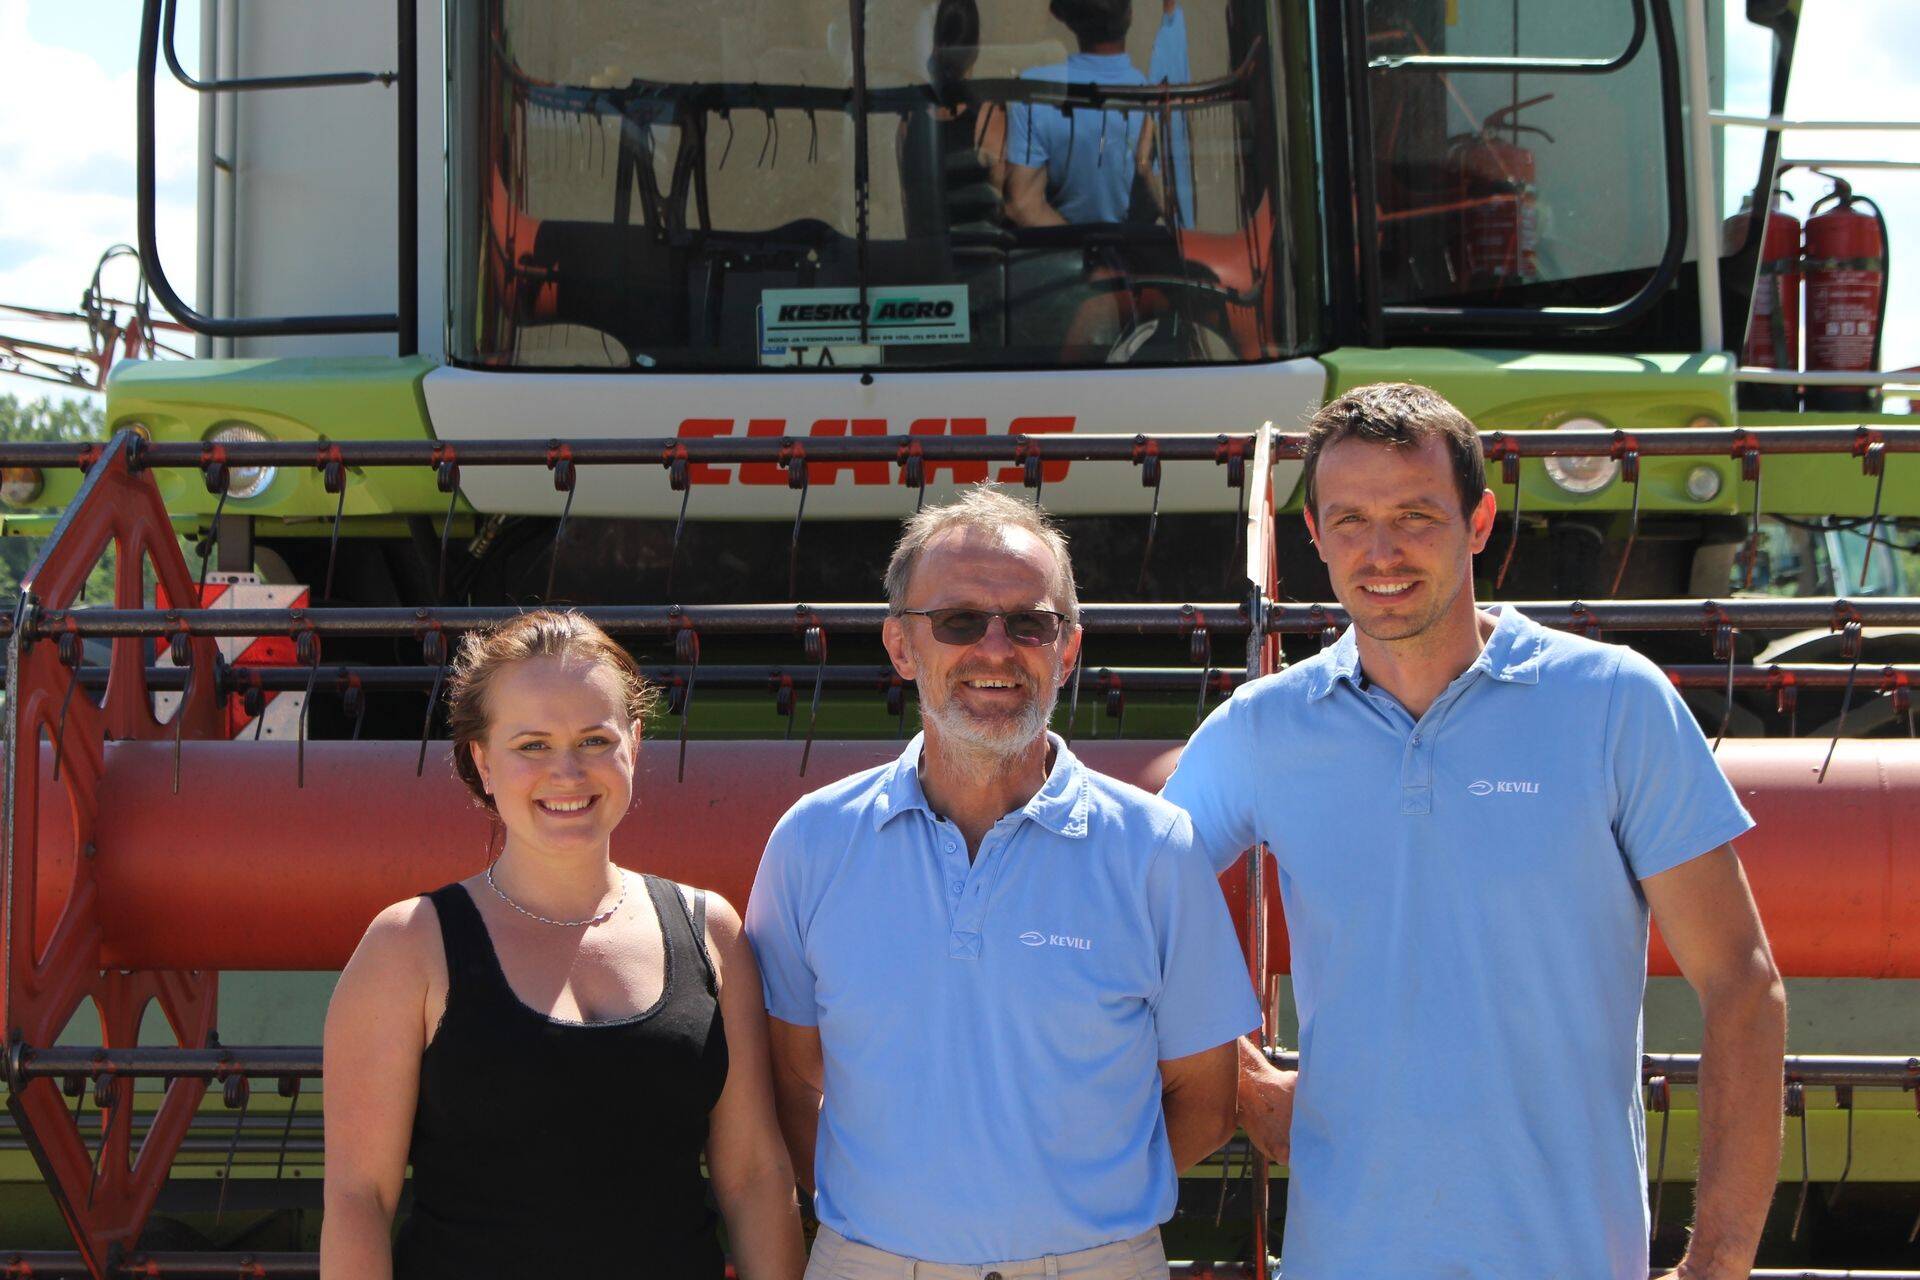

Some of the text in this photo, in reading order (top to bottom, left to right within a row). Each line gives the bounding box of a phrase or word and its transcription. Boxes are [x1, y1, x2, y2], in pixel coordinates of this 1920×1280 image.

[778, 300, 954, 322] KESKO AGRO
[676, 416, 1077, 485] CLAAS
[1497, 781, 1540, 794] KEVILI
[1049, 934, 1091, 950] KEVILI
